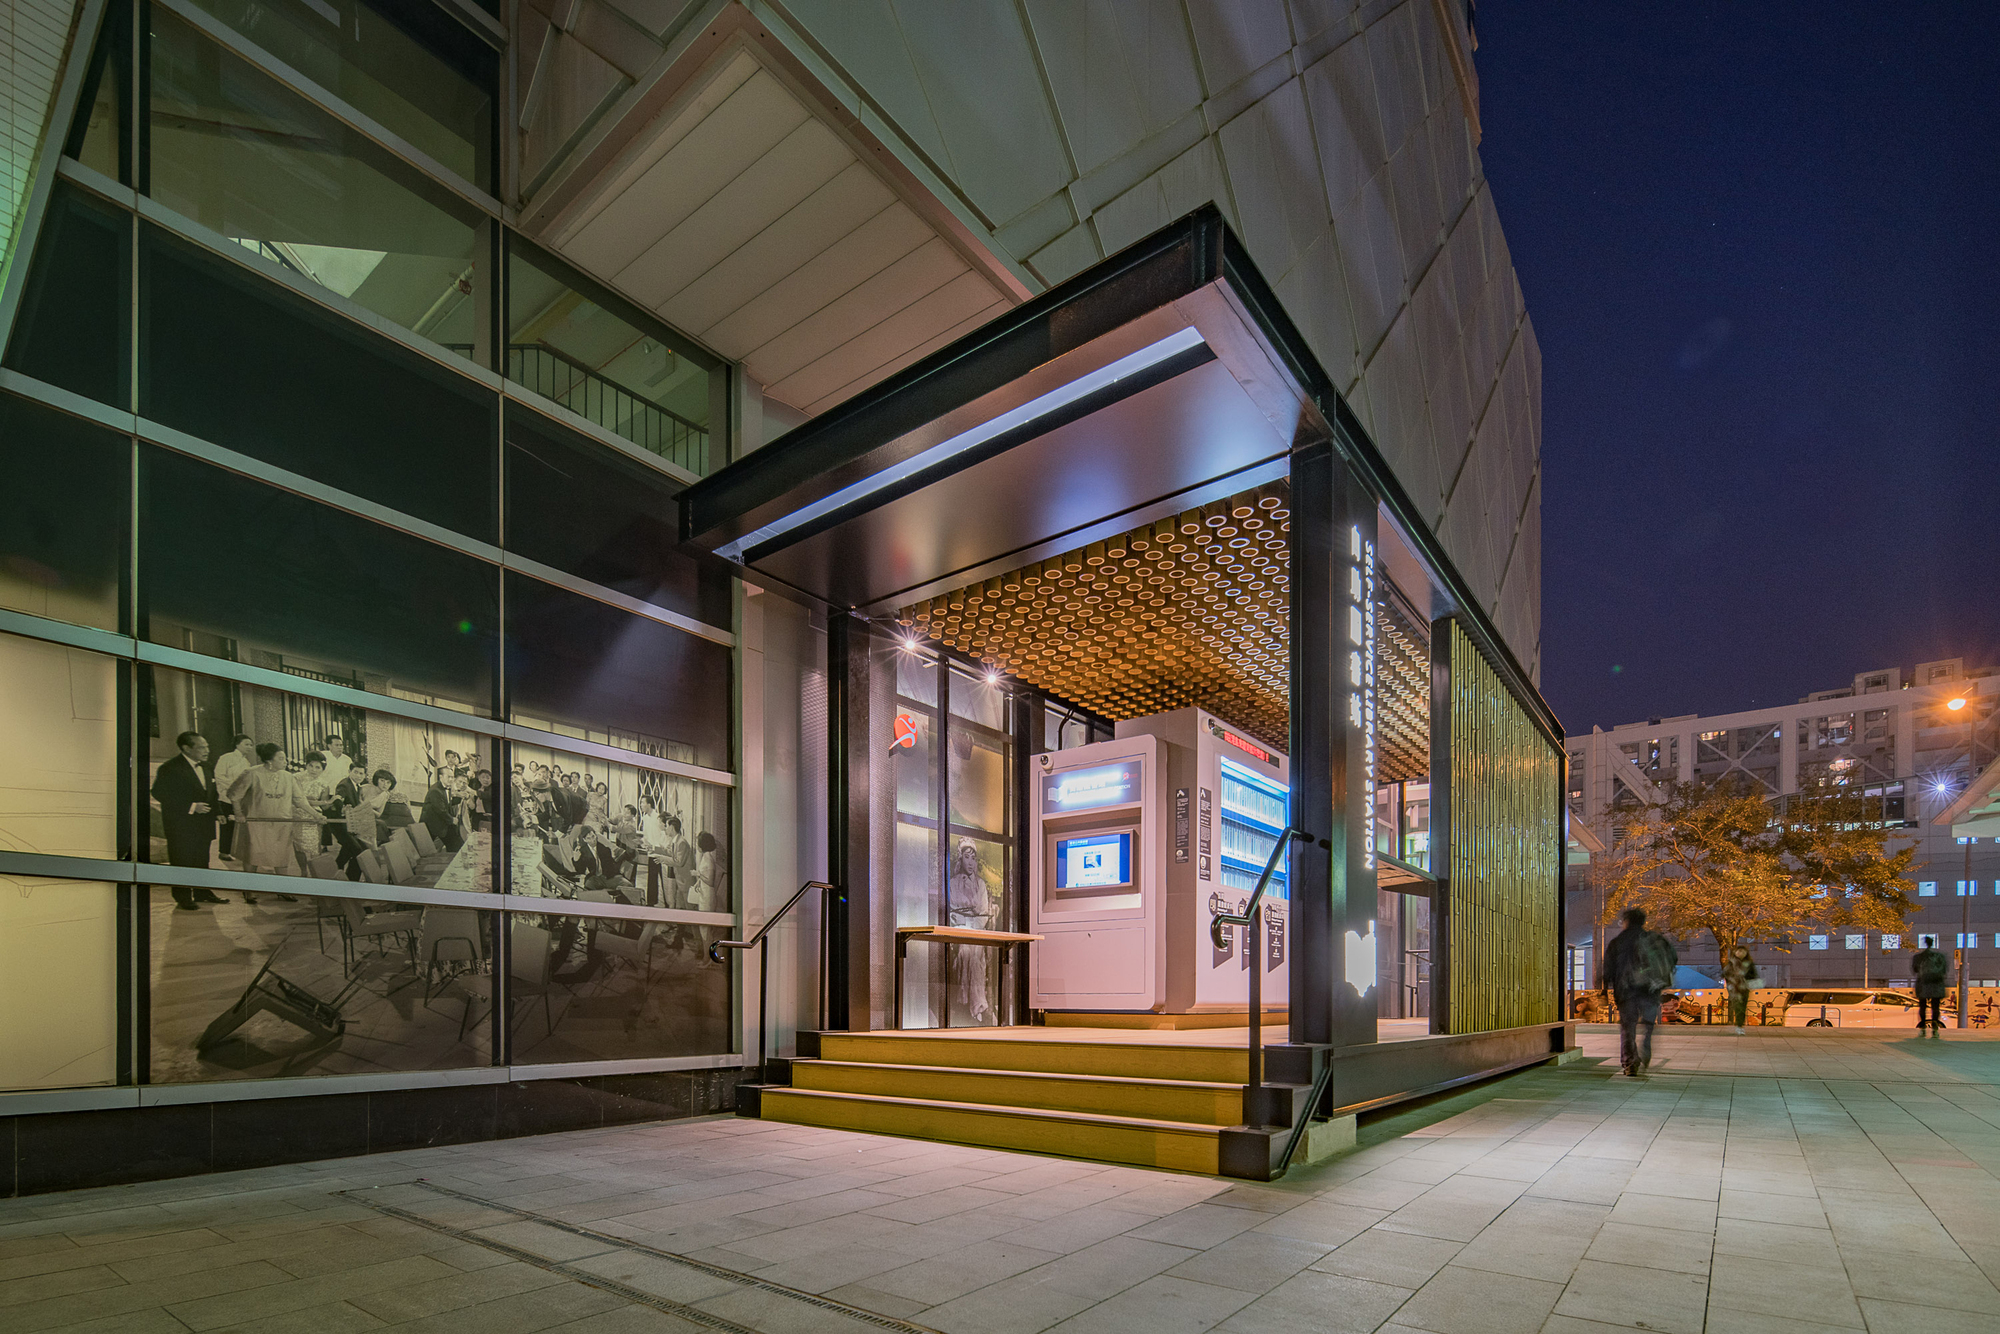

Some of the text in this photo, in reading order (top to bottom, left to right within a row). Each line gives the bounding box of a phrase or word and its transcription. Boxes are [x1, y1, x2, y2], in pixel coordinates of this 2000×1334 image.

[1365, 540, 1374, 870] SELF-SERVICE LIBRARY STATION
